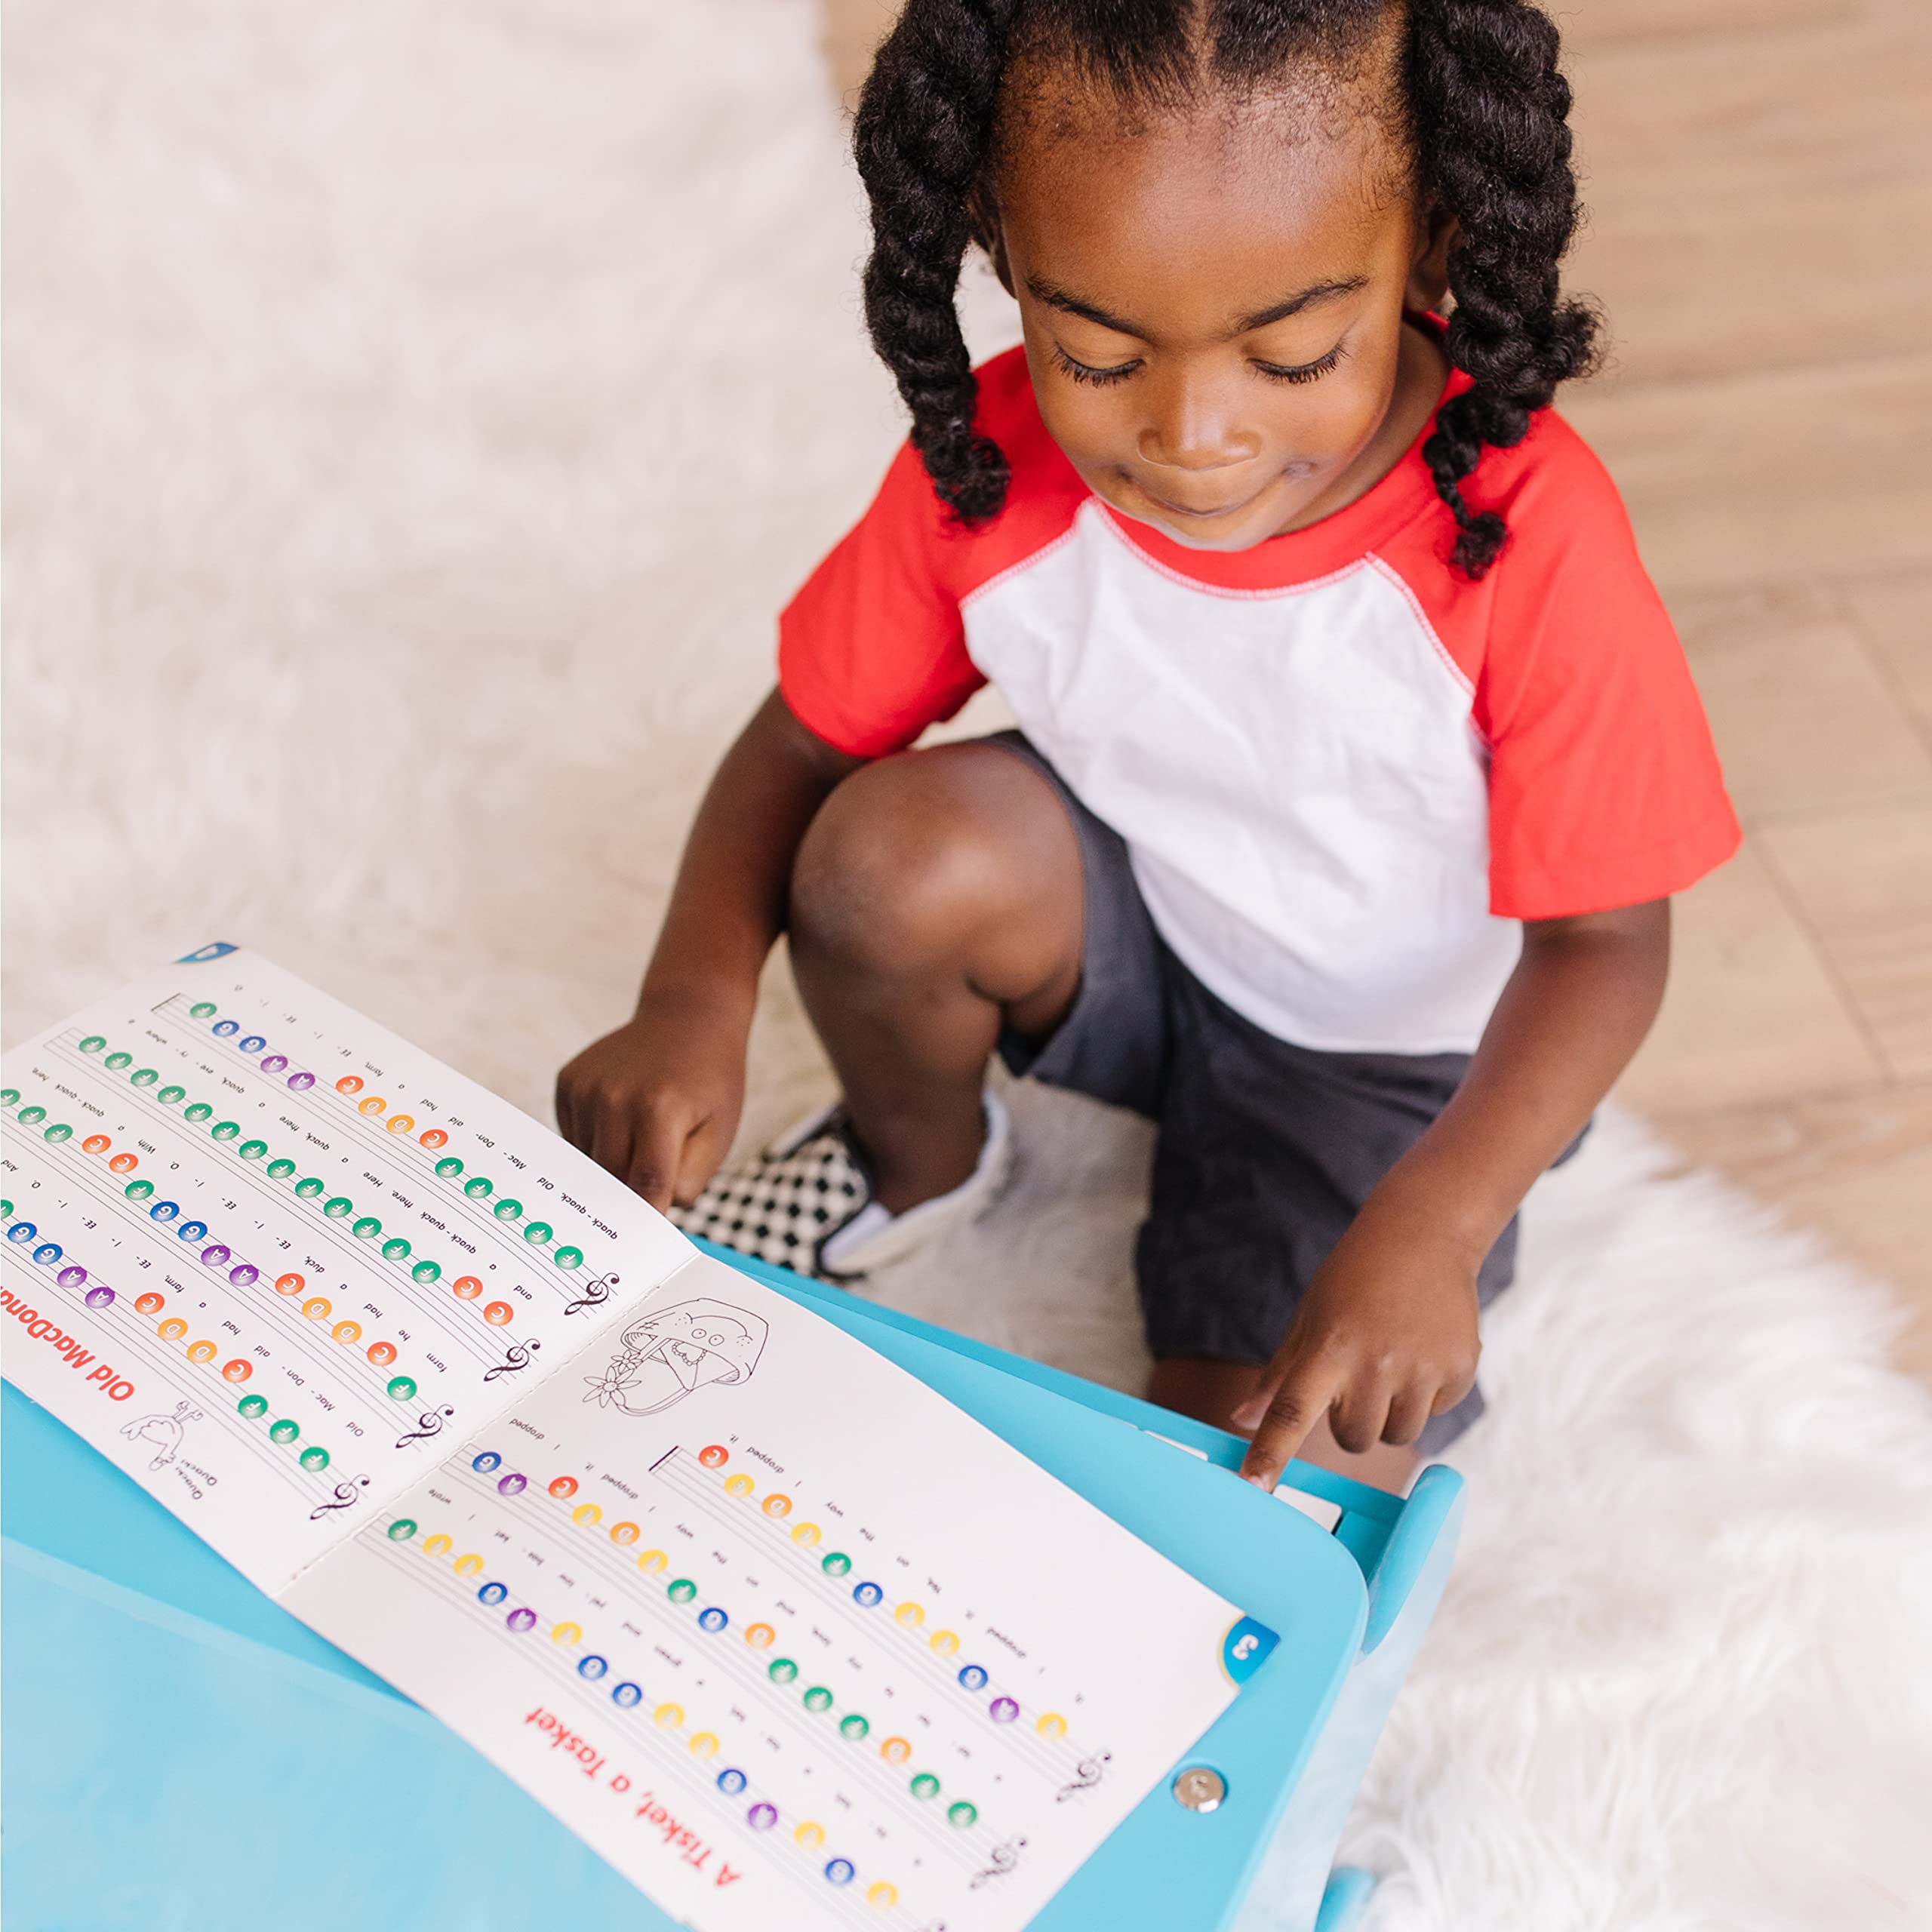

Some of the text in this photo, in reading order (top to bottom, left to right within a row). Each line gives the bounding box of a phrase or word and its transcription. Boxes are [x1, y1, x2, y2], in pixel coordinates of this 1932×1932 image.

[0, 1286, 135, 1401] Old MacDona
[1231, 1633, 1260, 1660] 3
[525, 1707, 740, 1887] A Tisket, a Tasket
